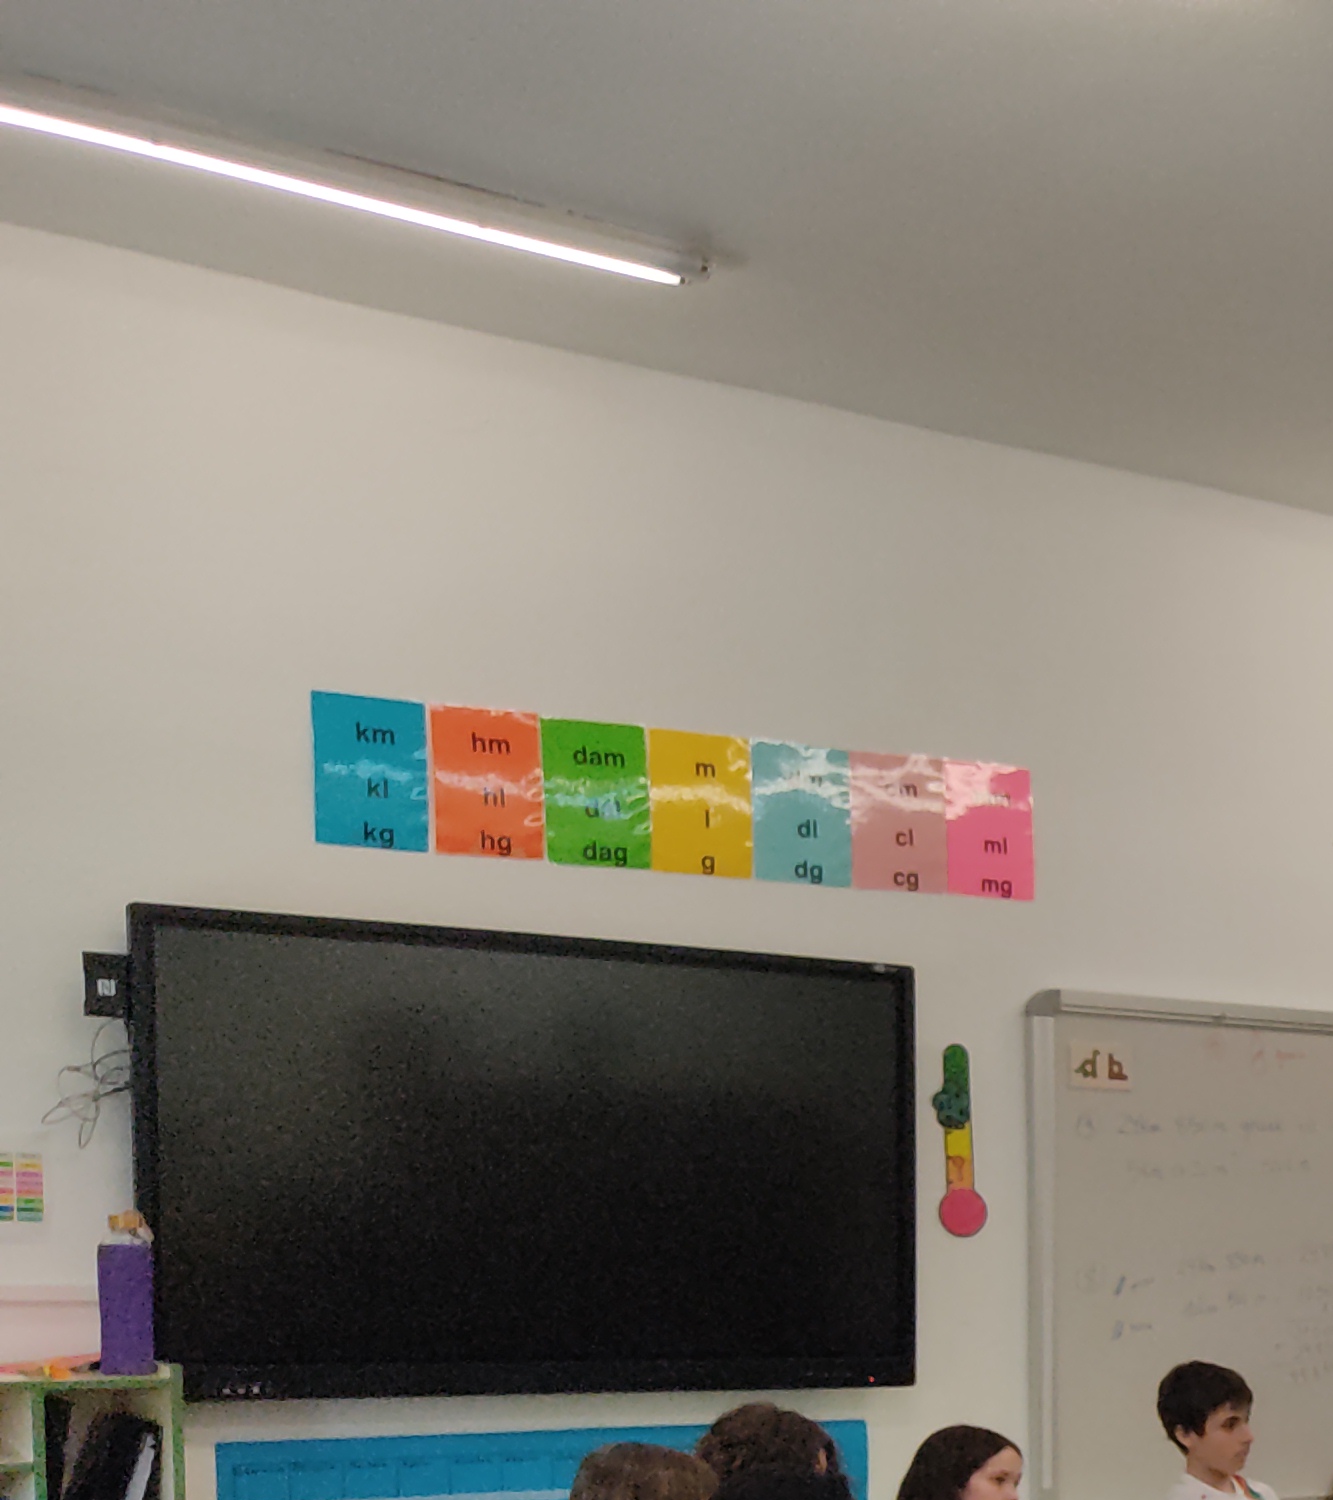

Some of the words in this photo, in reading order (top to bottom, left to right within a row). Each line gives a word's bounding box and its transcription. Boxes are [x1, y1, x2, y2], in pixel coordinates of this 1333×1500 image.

[356, 721, 396, 746] km
[471, 732, 511, 756] hm
[573, 746, 626, 769] dam
[695, 760, 716, 778] m
[367, 778, 389, 799] kl
[363, 821, 395, 849] kg
[797, 819, 818, 838] dl
[895, 829, 914, 847] cl
[480, 830, 513, 856] hg
[582, 841, 628, 868] dag
[984, 836, 1008, 856] ml
[701, 855, 716, 875] g
[794, 860, 824, 884] dg
[893, 870, 920, 891] cg
[981, 875, 1013, 898] mg
